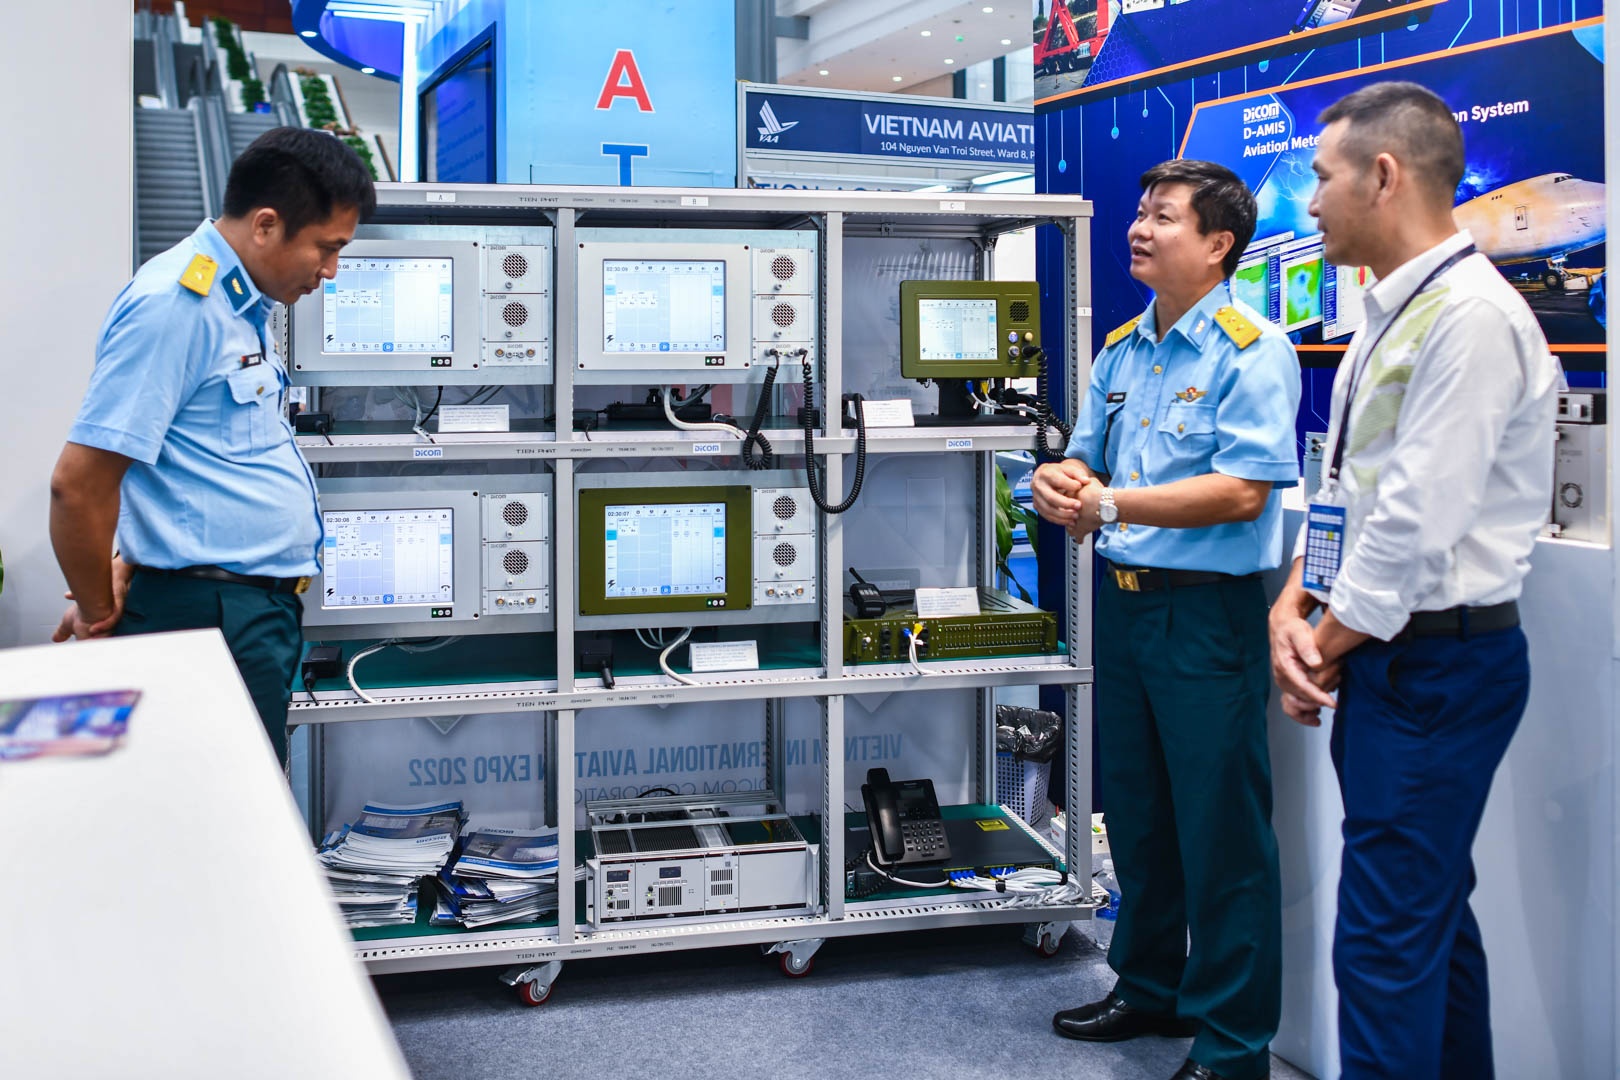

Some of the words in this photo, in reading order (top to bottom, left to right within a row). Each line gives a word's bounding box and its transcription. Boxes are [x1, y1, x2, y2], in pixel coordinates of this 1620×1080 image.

[864, 113, 964, 140] VIETNAM
[1243, 140, 1289, 158] Aviation
[1471, 100, 1530, 123] System
[1243, 120, 1286, 140] D-AMIS
[759, 134, 780, 143] VAA
[881, 141, 897, 151] 104
[899, 142, 932, 155] Nguyen
[933, 144, 950, 155] Van
[951, 145, 968, 156] Troi
[969, 146, 996, 159] Street,
[997, 148, 1020, 159] Ward
[1020, 150, 1029, 160] 8,
